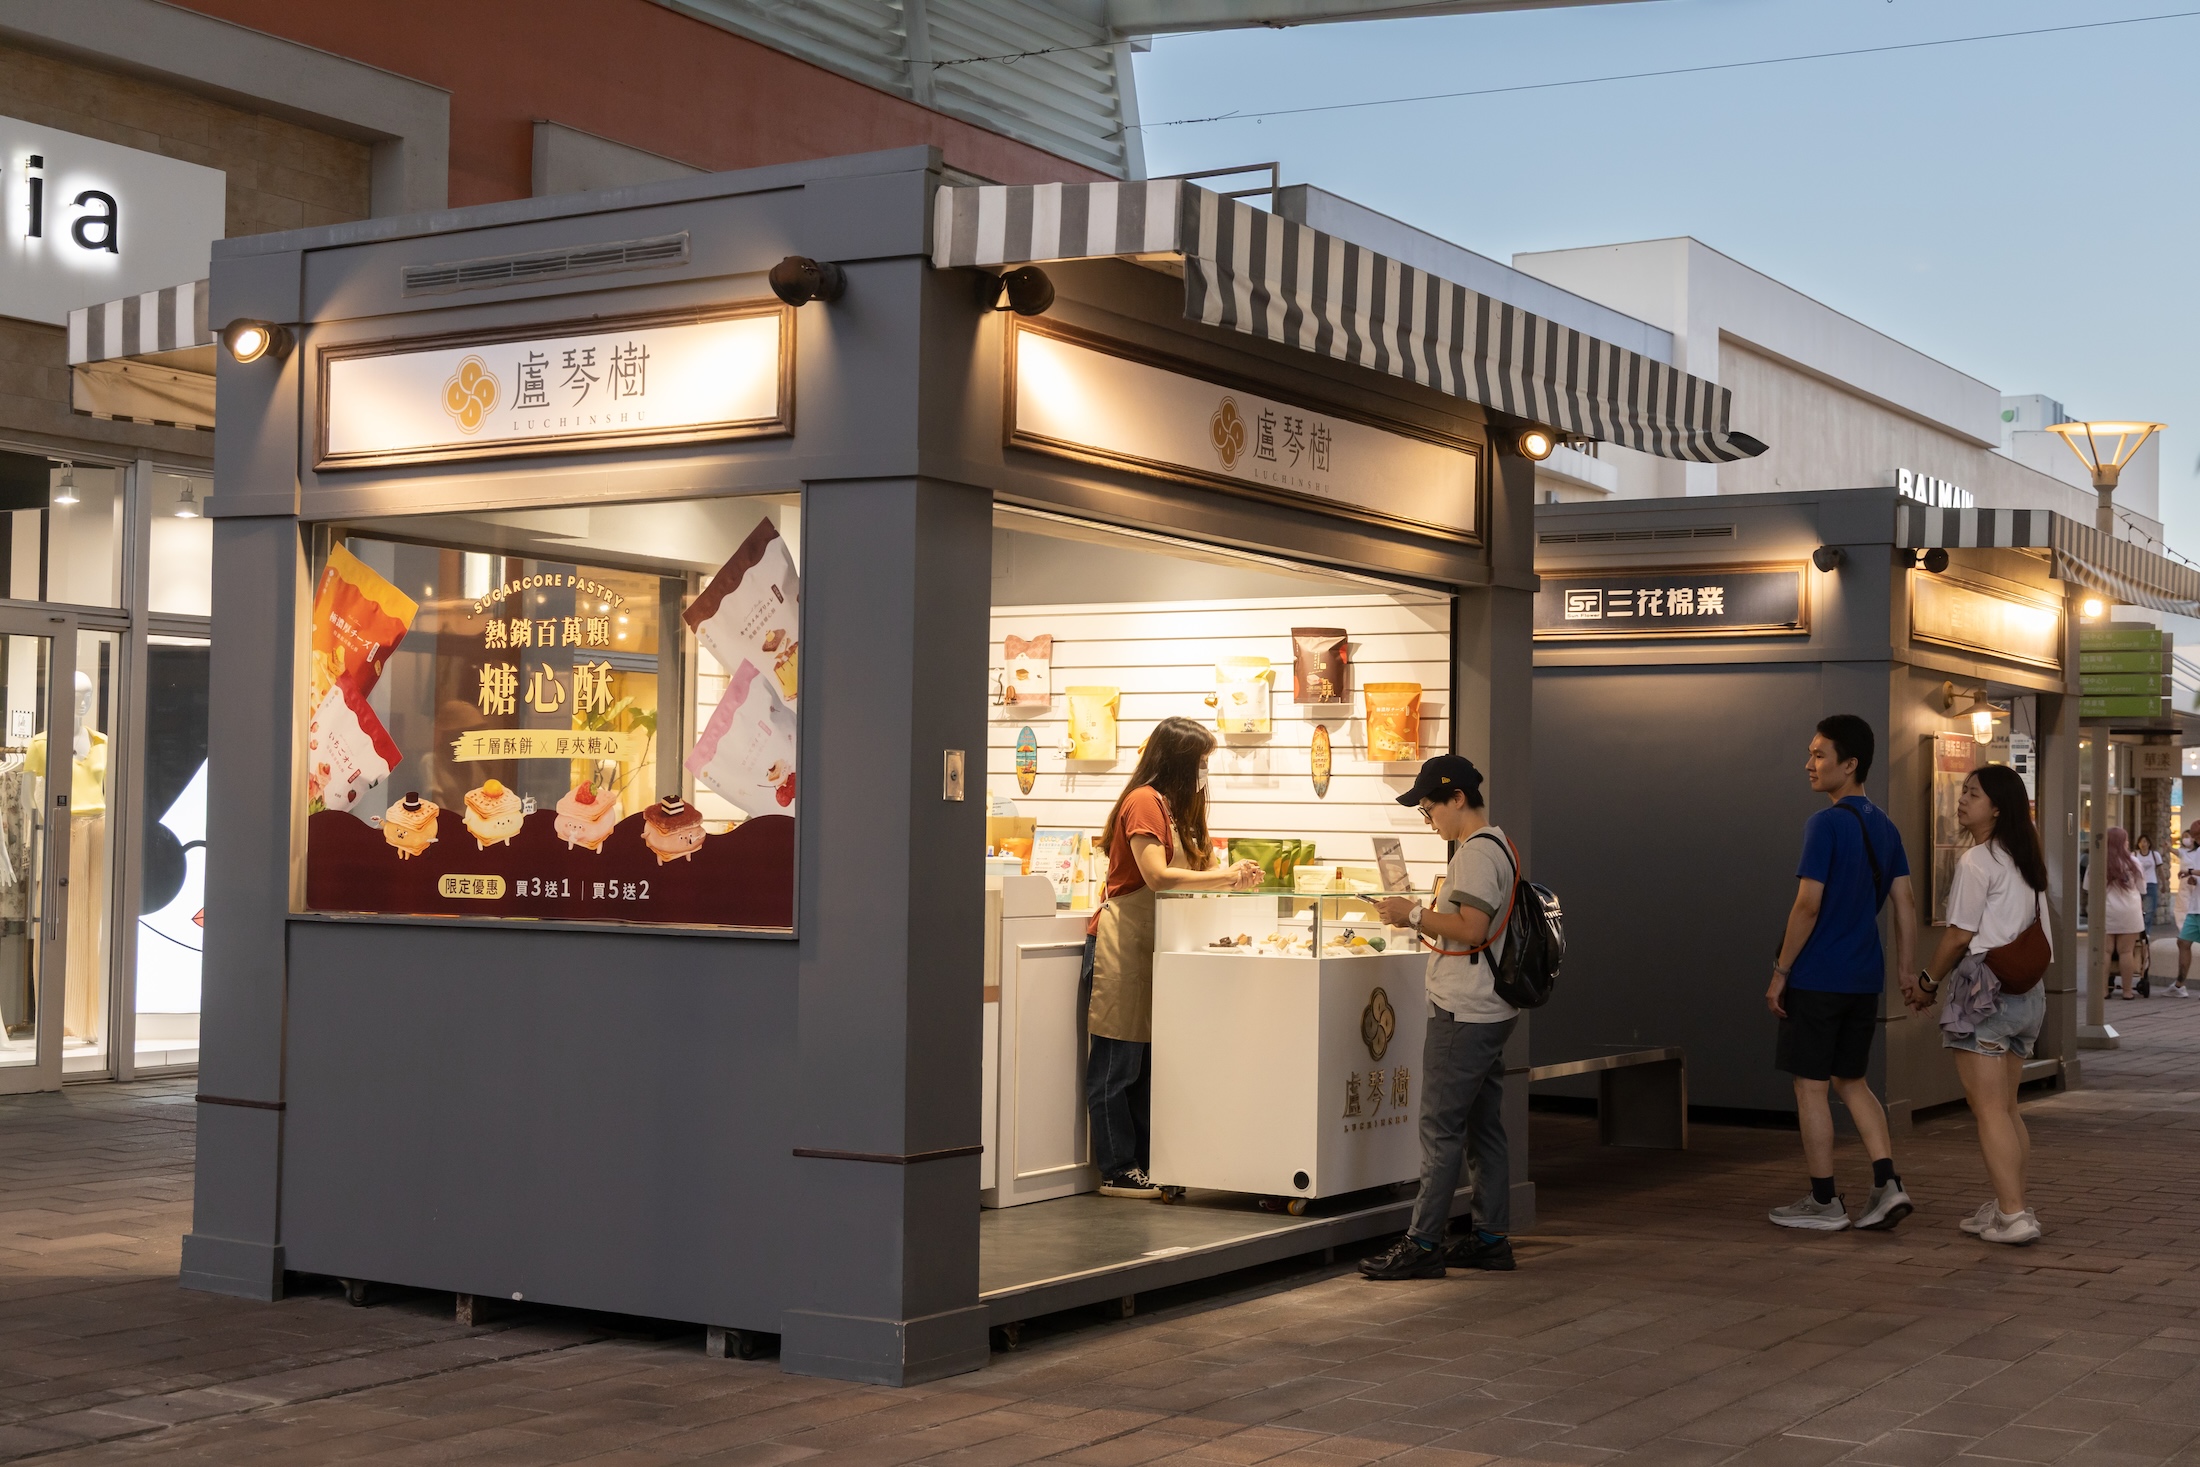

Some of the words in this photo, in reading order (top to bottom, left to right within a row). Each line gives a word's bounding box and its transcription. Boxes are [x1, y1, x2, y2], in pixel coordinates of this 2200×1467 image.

[0, 154, 119, 254] ia
[510, 340, 650, 411] 盧琴樹
[513, 411, 646, 430] LUCHINSHU
[1252, 407, 1332, 473] 盧琴樹
[1254, 468, 1330, 493] LUCHINSHU
[473, 573, 562, 615] SUGARCORE
[567, 574, 624, 608] PASTRY
[1568, 595, 1598, 612] SF
[1606, 586, 1724, 617] 三花棉業
[484, 615, 610, 649] 熱銷百萬顆
[477, 660, 614, 716] 糖心酥
[472, 736, 533, 755] 千層酥餅
[555, 736, 619, 755] 厚夾糖心
[445, 878, 498, 896] 限定優惠
[515, 877, 571, 898] 買3送1
[592, 879, 650, 901] 買5送2
[1342, 1065, 1410, 1119] 盧琴樹
